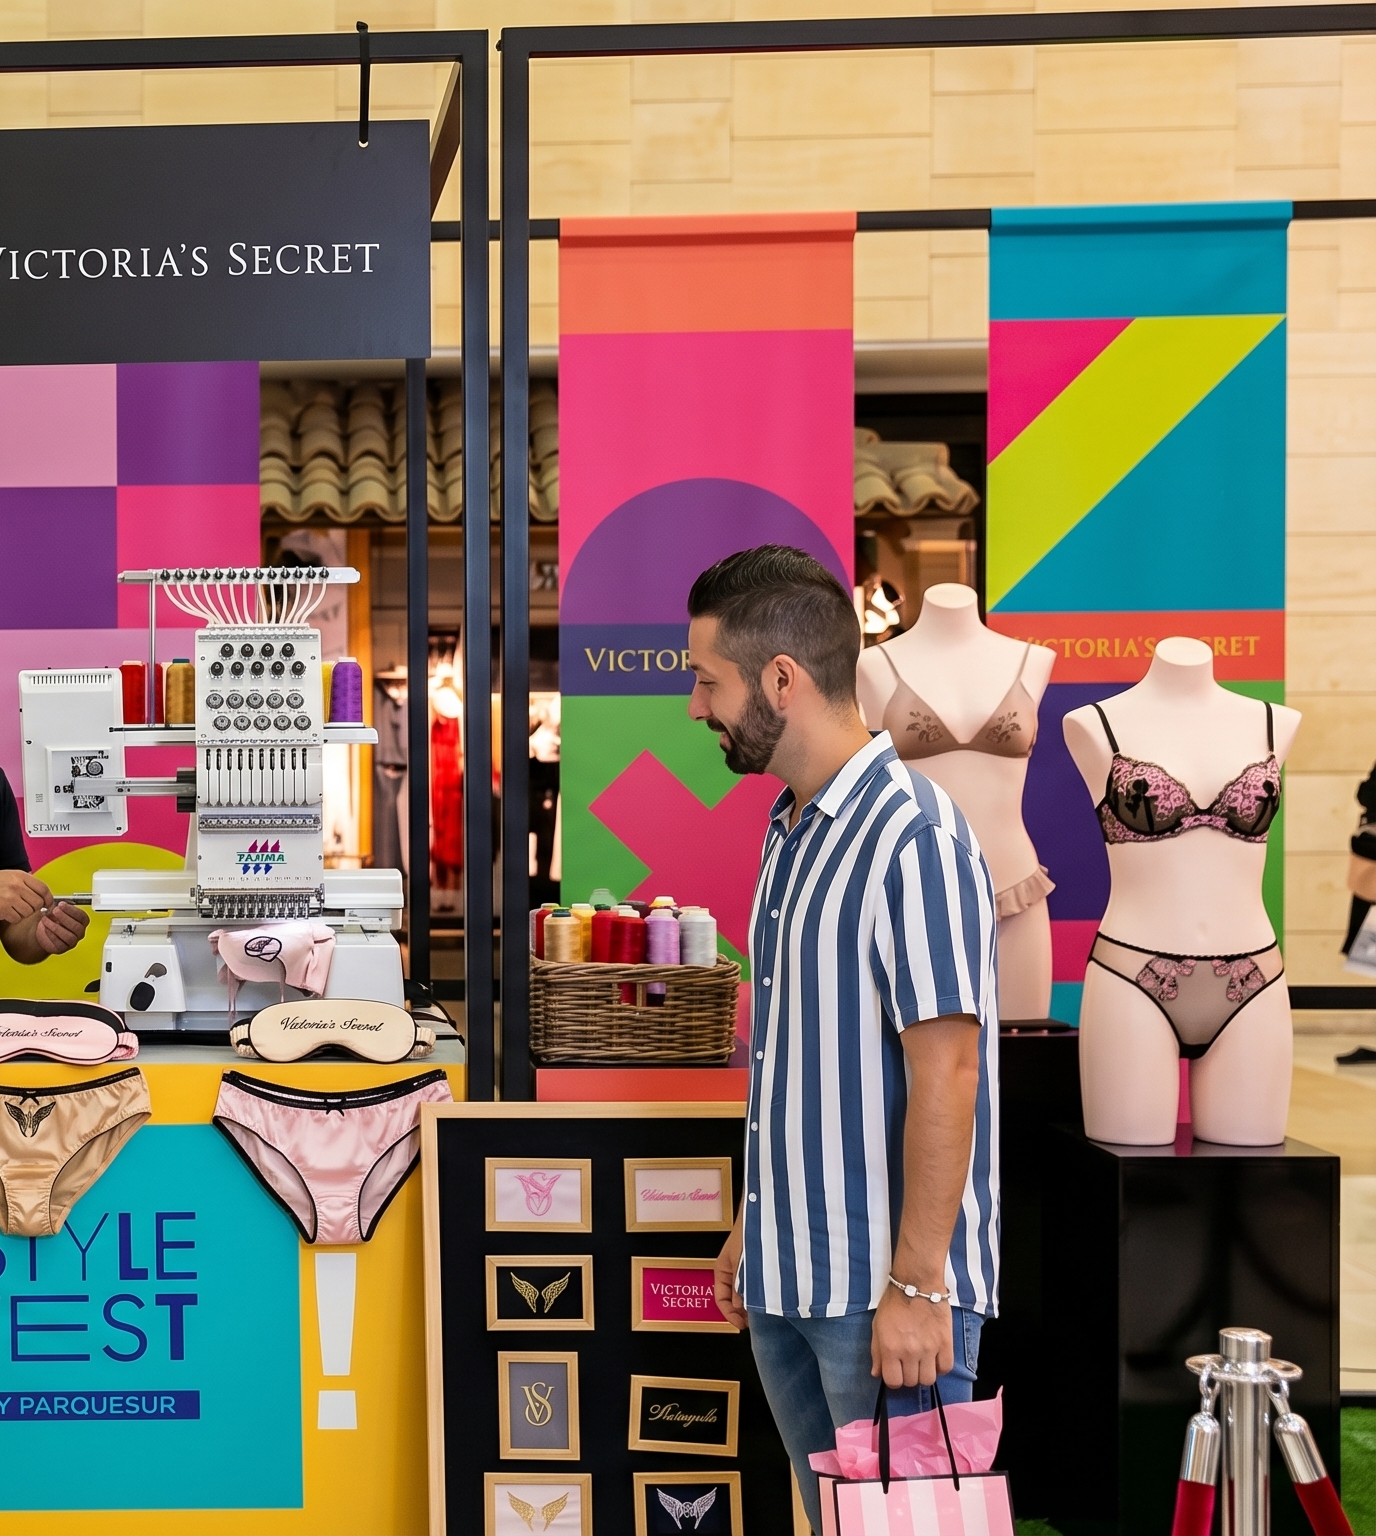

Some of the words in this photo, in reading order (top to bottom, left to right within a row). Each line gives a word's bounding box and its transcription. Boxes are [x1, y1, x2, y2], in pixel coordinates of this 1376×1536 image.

[227, 241, 381, 276] SECRET
[1013, 636, 1156, 658] TORIA'S
[662, 1296, 711, 1309] SECRET
[19, 1396, 177, 1417] PARQUESUR
